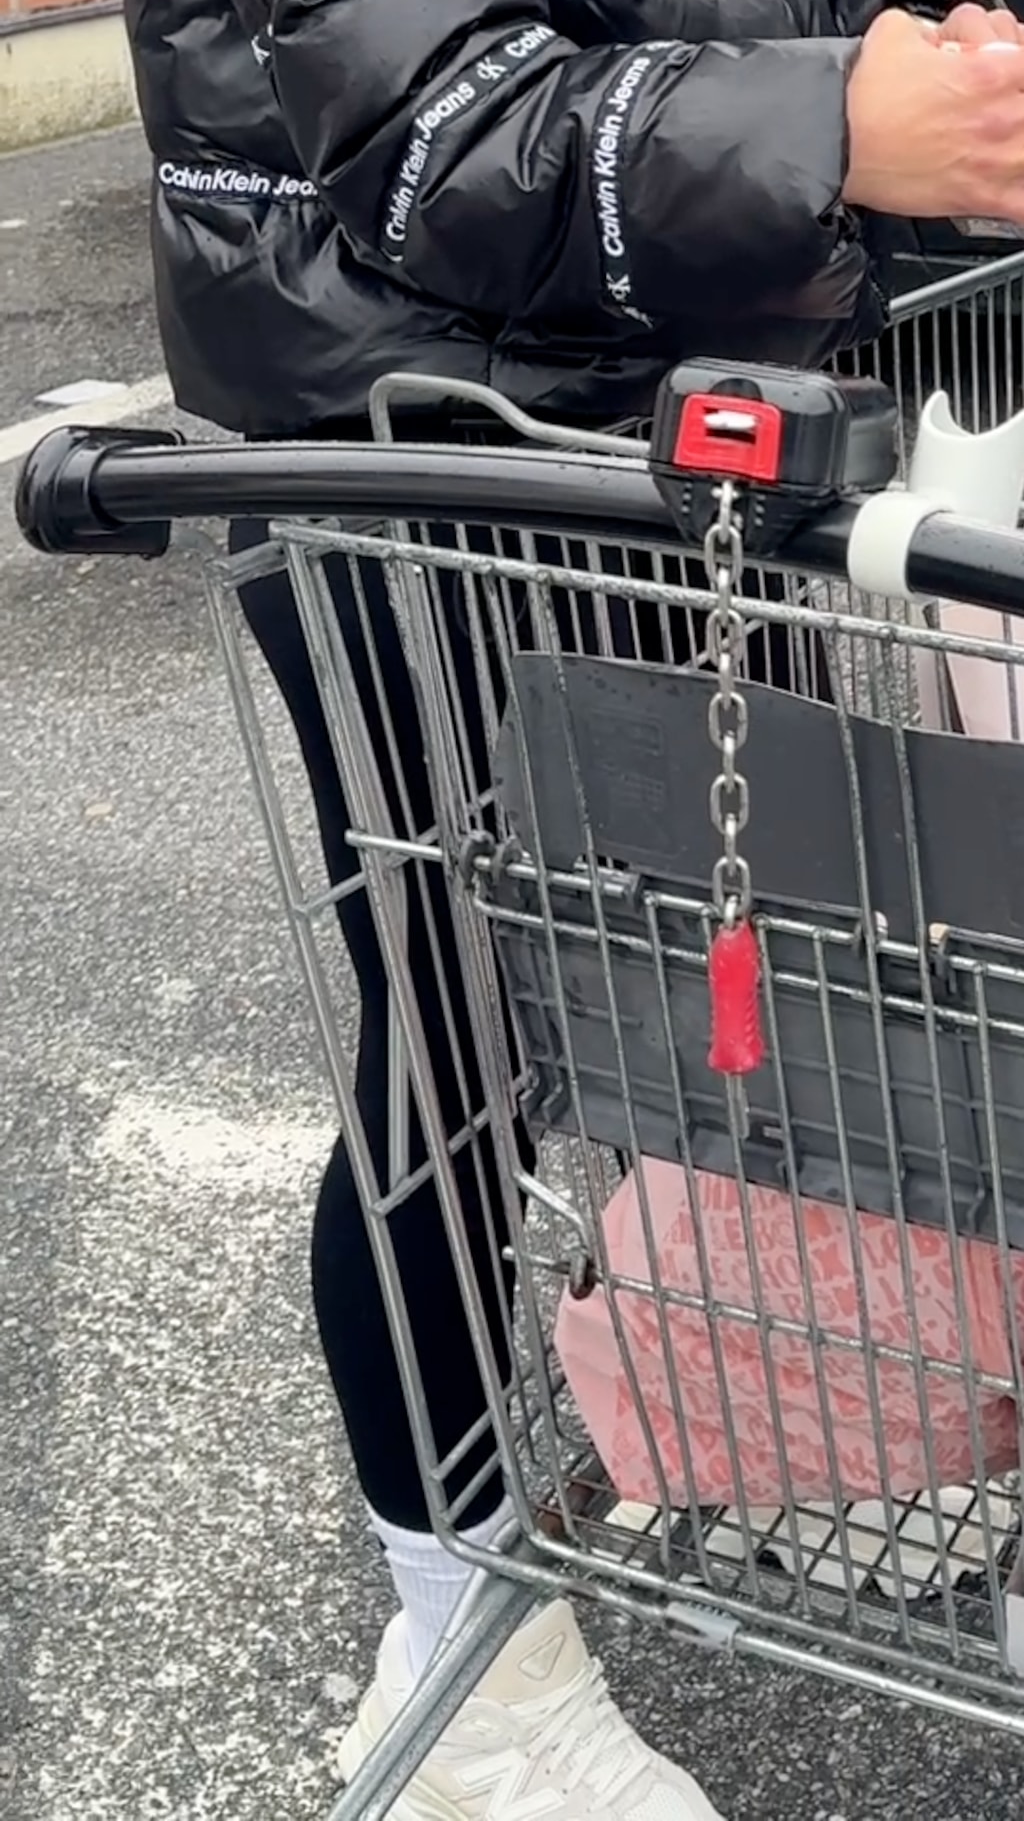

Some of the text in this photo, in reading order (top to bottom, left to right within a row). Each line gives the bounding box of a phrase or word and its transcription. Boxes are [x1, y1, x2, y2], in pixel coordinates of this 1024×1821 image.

[415, 80, 477, 141] Jeans
[607, 56, 651, 114] Jeans
[400, 136, 432, 188] Klein
[593, 116, 623, 179] Klein
[211, 167, 271, 195] Klein
[386, 187, 415, 242] Calvin
[598, 179, 625, 258] Calvin
